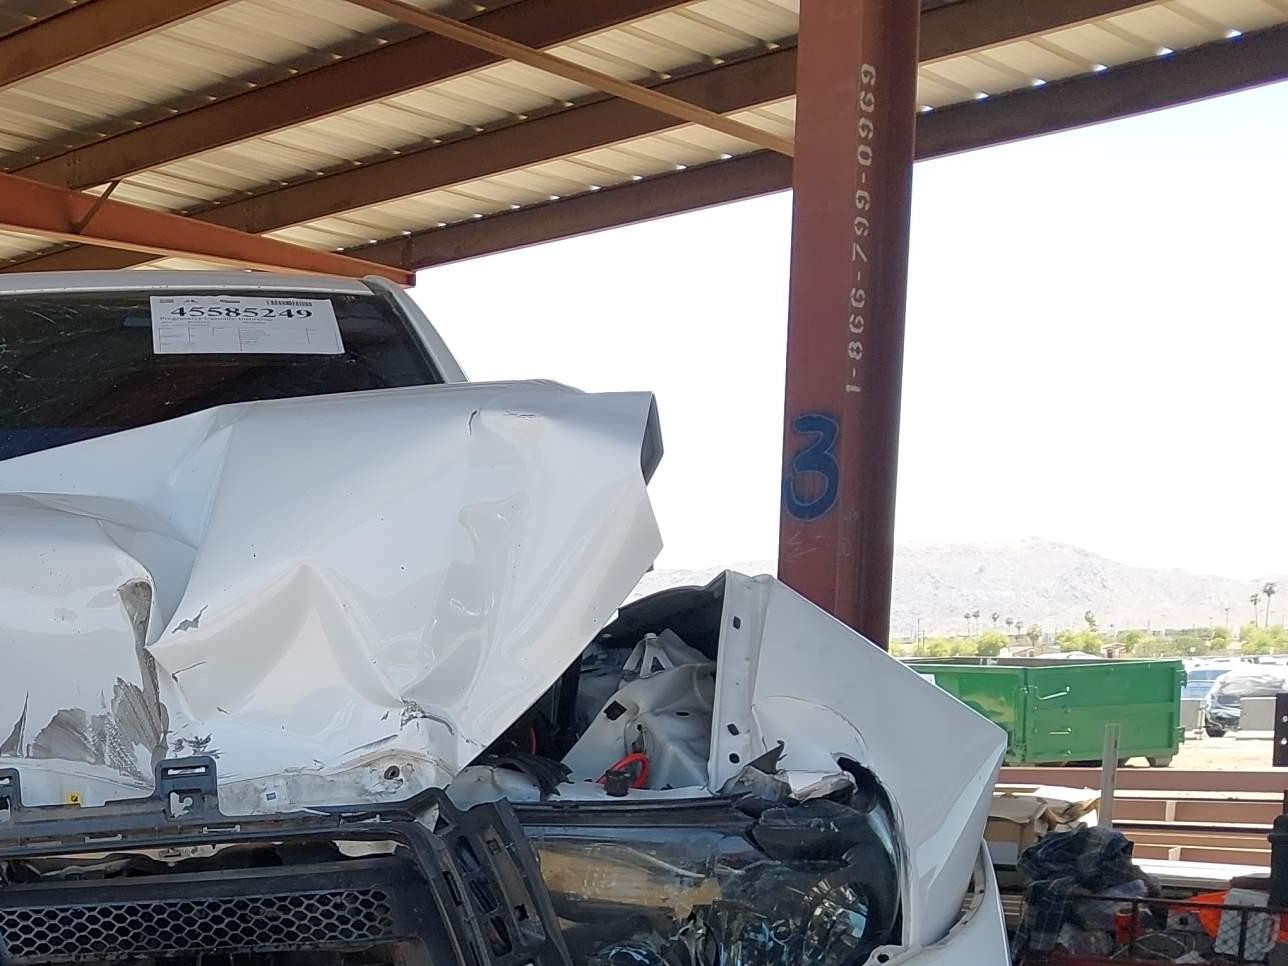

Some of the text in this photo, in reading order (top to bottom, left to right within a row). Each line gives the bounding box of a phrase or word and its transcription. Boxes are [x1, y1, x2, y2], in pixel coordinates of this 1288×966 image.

[845, 63, 877, 393] 1-866-799-0969
[170, 306, 313, 319] 45585249
[782, 413, 840, 521] 3
